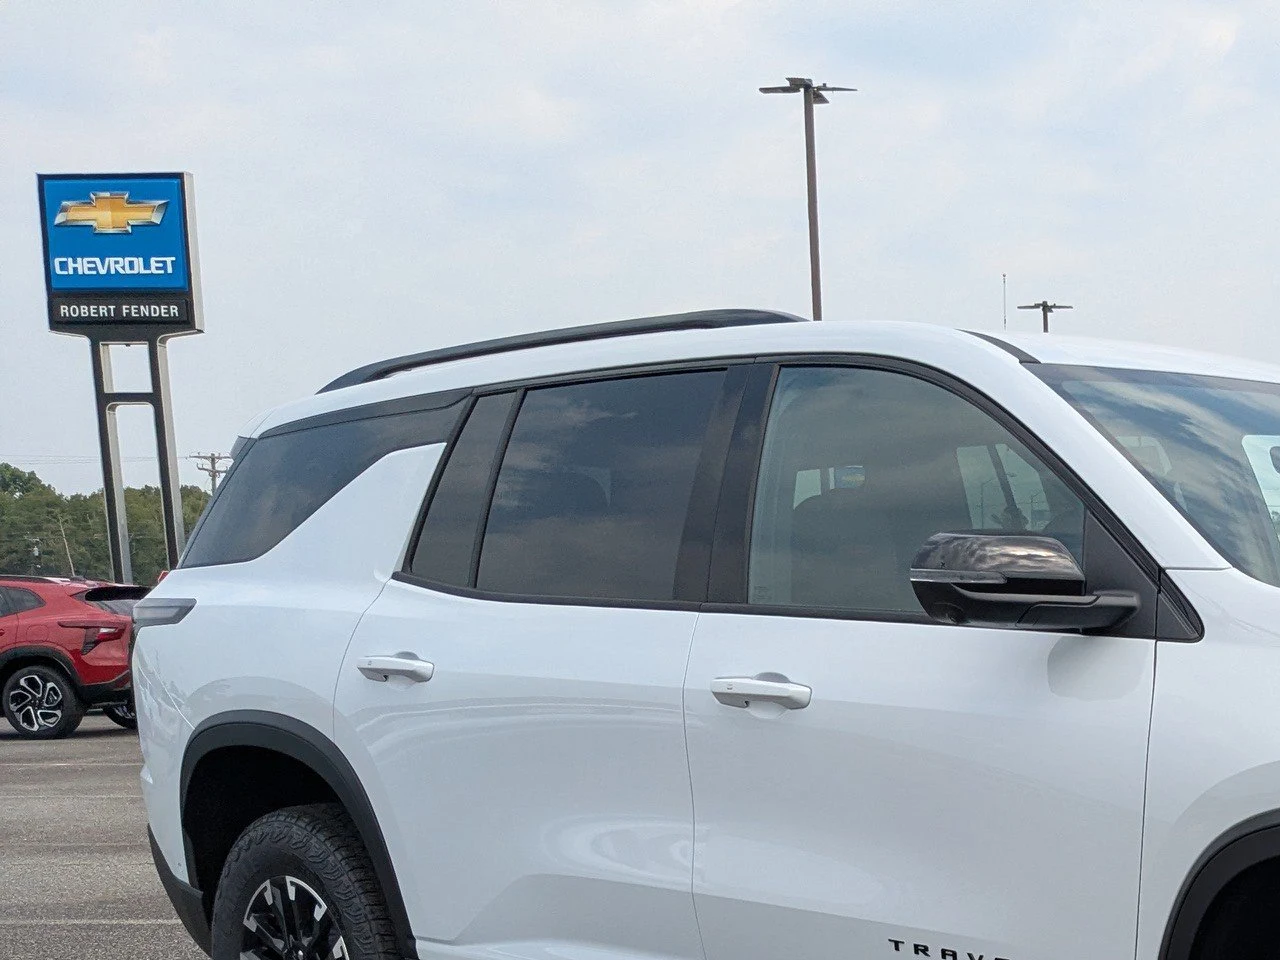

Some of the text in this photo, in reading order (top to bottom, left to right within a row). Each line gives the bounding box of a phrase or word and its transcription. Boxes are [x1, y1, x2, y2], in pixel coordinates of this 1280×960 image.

[54, 257, 176, 275] CHEVROLET
[60, 305, 179, 317] ROBERT FENDER
